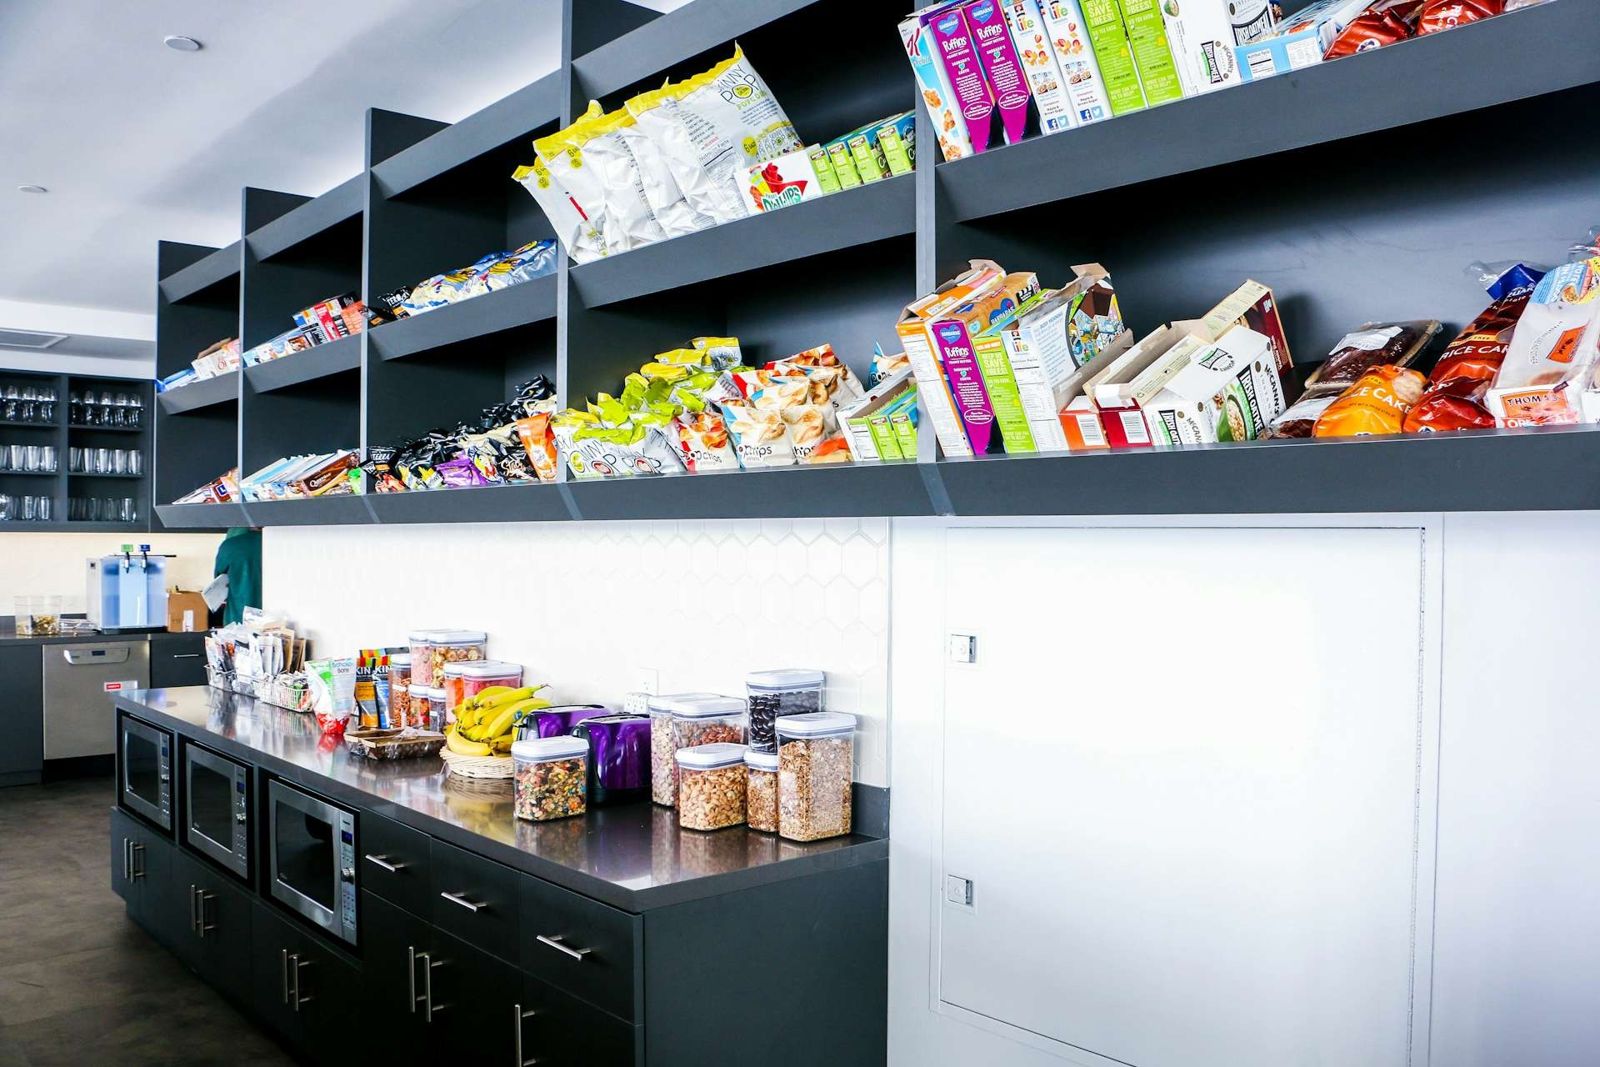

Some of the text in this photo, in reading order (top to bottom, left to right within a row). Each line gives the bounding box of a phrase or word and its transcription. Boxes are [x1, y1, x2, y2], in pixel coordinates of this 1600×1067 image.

[976, 23, 1003, 41] Puffins
[942, 36, 968, 53] Puffins
[721, 74, 759, 104] POP
[944, 346, 969, 358] Puffins
[1438, 345, 1476, 362] RICE
[1240, 369, 1255, 399] IRISH
